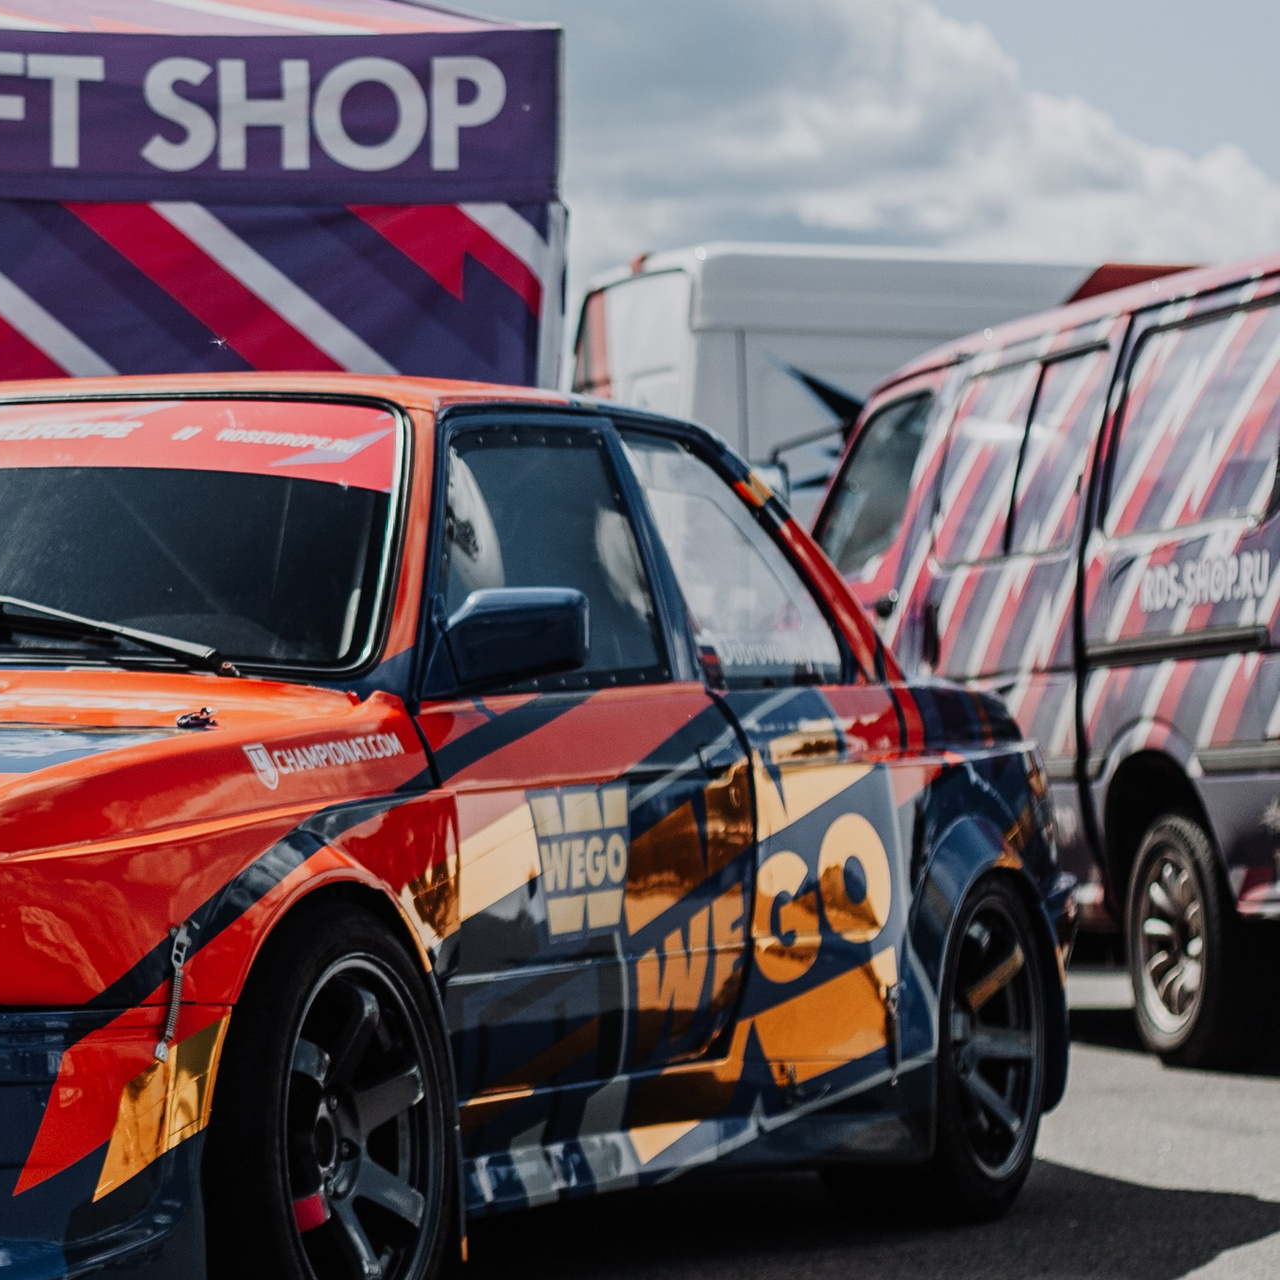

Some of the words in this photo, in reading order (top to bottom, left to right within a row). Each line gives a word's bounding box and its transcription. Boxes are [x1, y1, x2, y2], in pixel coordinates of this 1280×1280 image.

[143, 57, 506, 171] SHOP
[1139, 548, 1270, 614] RDS-SHOP.RU
[272, 732, 405, 775] CHAMPIONAT.COM
[539, 833, 628, 893] WEGO
[635, 812, 892, 1048] WEGO
